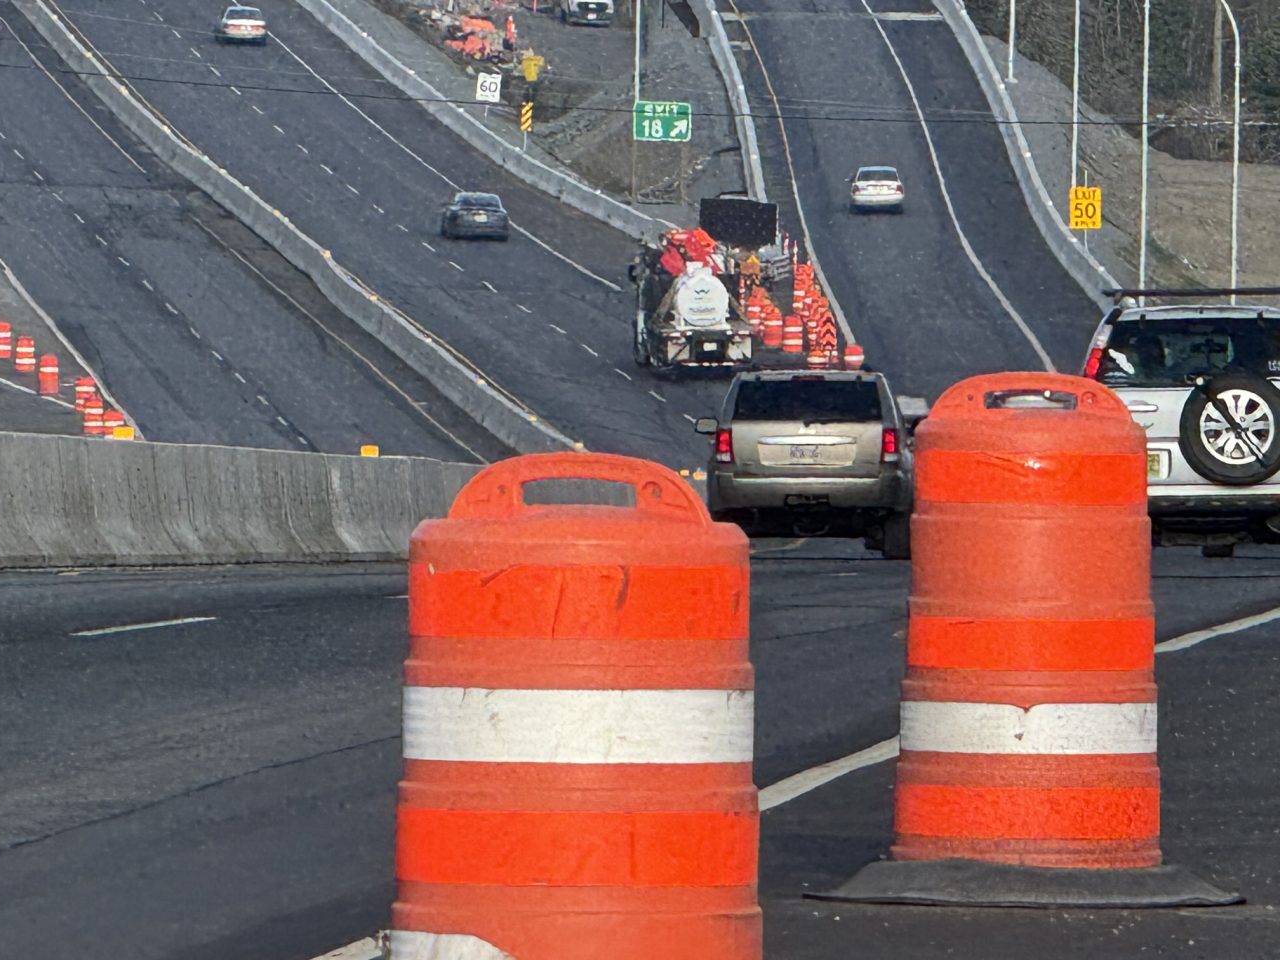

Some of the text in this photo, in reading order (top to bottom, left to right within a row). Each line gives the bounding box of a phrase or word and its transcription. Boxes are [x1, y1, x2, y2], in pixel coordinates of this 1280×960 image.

[480, 80, 498, 93] 60
[642, 119, 663, 138] 18
[1074, 202, 1097, 219] 50
